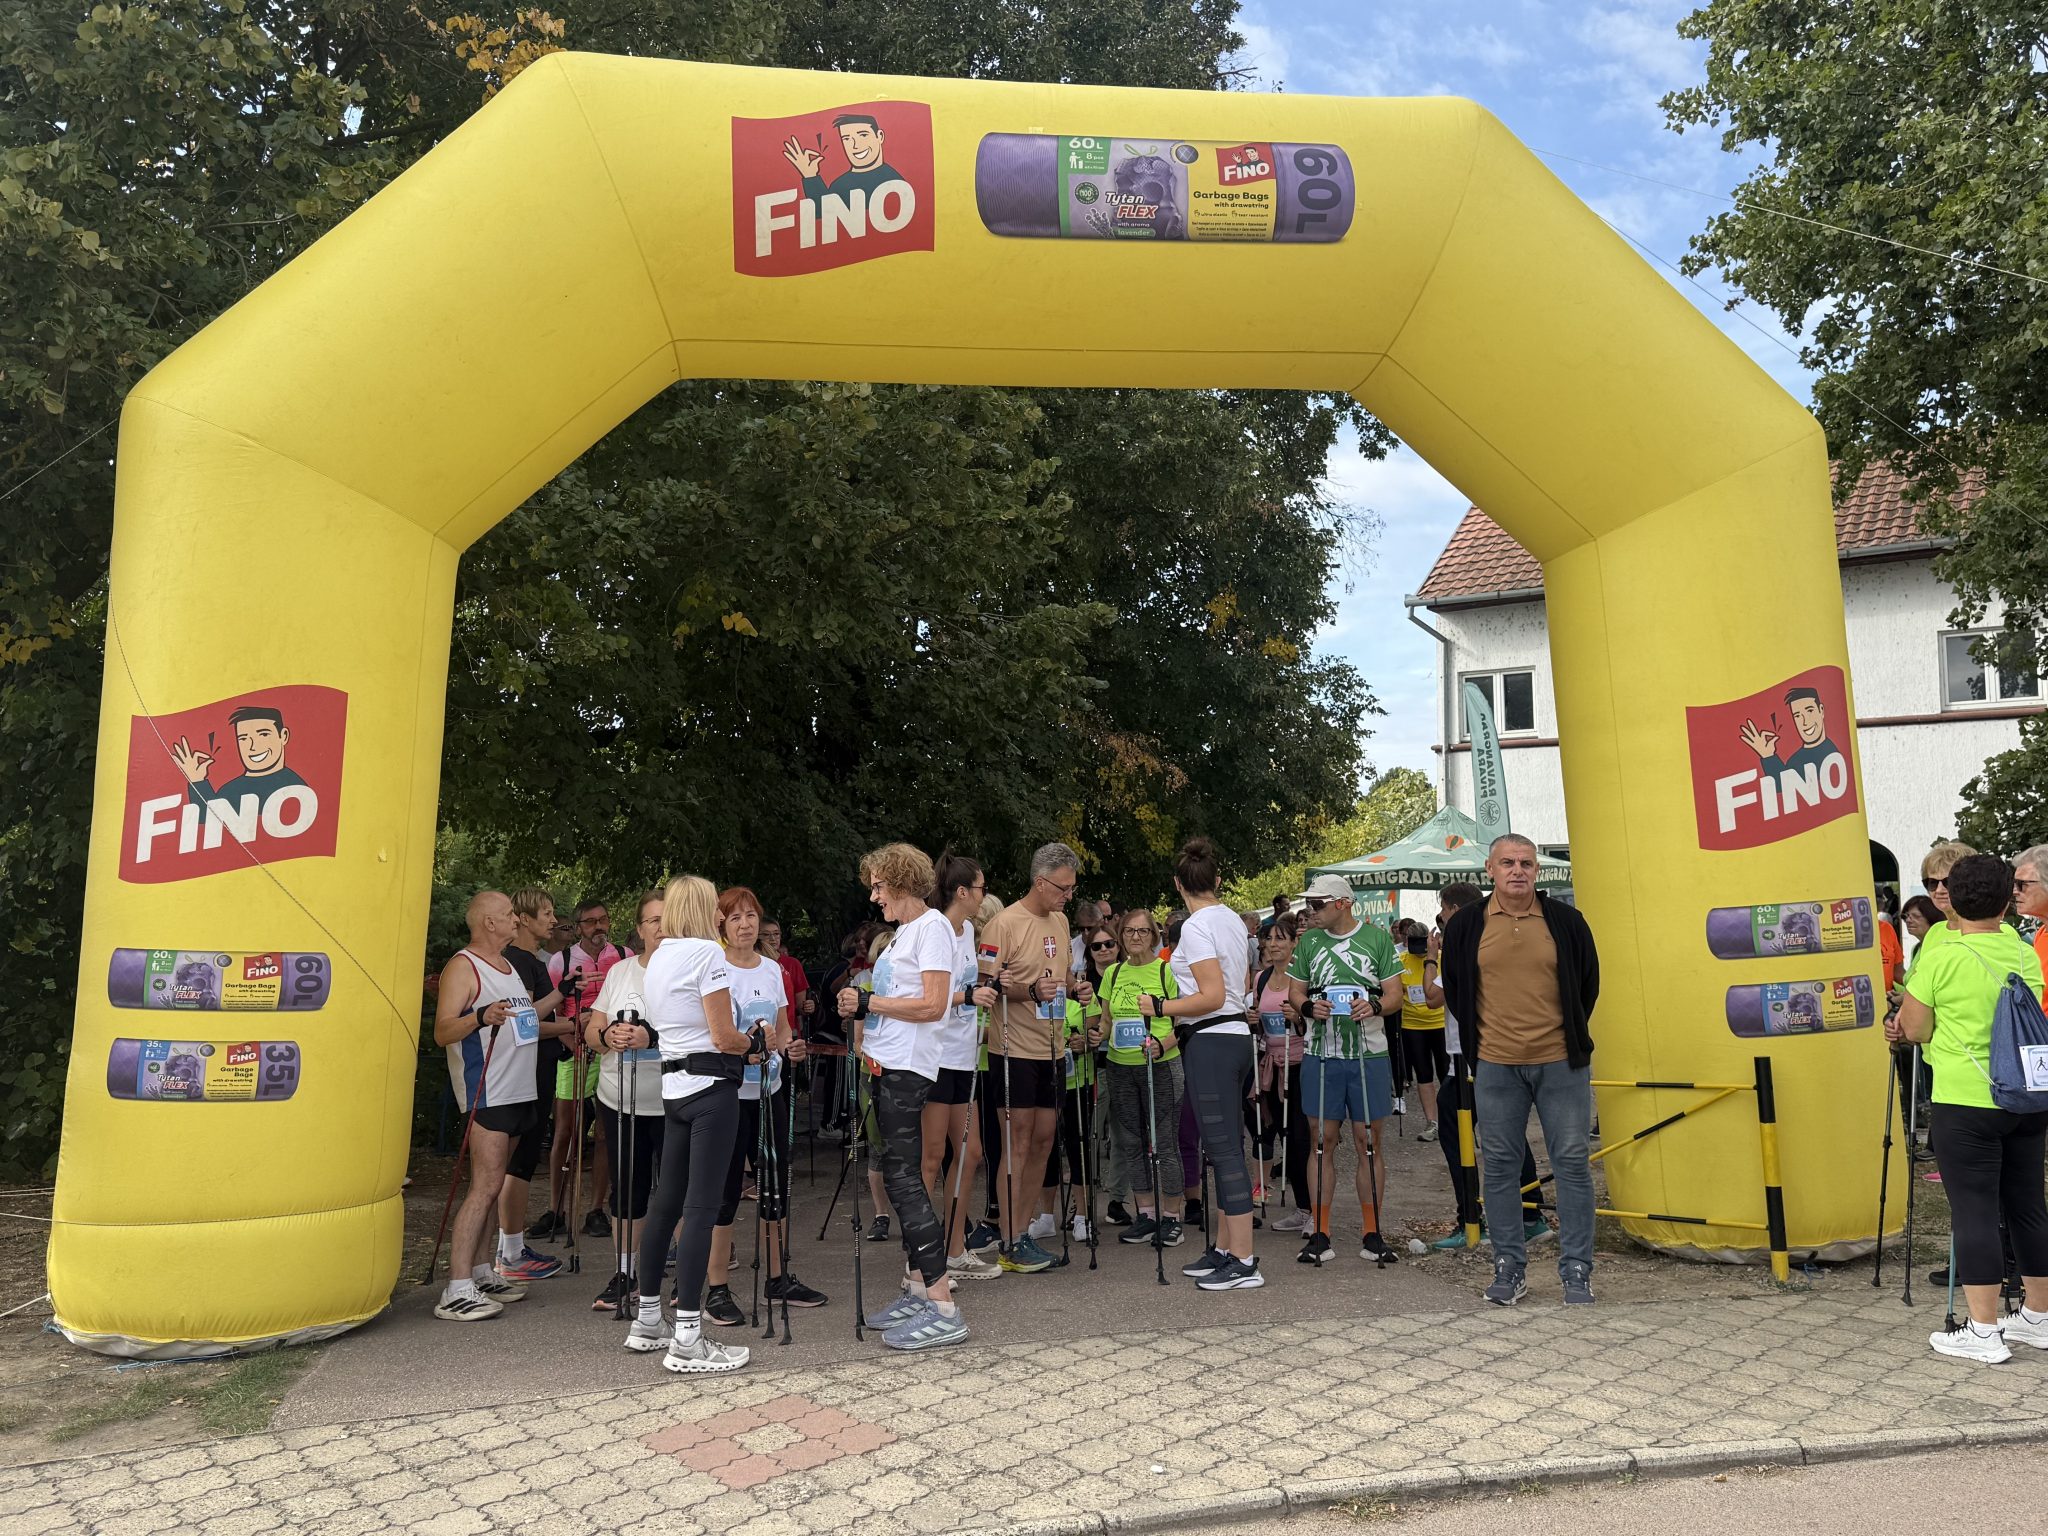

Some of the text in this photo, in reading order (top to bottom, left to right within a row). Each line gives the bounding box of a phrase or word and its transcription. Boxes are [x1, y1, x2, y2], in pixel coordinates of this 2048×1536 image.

[1069, 137, 1104, 150] 60L
[1224, 162, 1270, 181] FINO
[1193, 191, 1269, 202] Garbage Bags
[1293, 148, 1342, 234] 60L
[1105, 191, 1144, 206] Tytan
[753, 179, 915, 258] FINO
[1117, 205, 1158, 219] FLEX
[1714, 752, 1848, 834] FINO
[135, 784, 319, 864] FINO
[1344, 870, 1495, 886] AVANGRAD PIVAR
[1834, 910, 1852, 922] FINO
[1858, 900, 1871, 944] 60L
[247, 966, 278, 977] FINO
[293, 956, 322, 1006] 60L
[176, 991, 201, 999] FLEX
[1836, 987, 1852, 997] FINO
[1123, 1028, 1143, 1036] 019
[230, 1053, 256, 1063] FINO
[263, 1045, 295, 1096] 35L
[164, 1081, 189, 1089] FLEX
